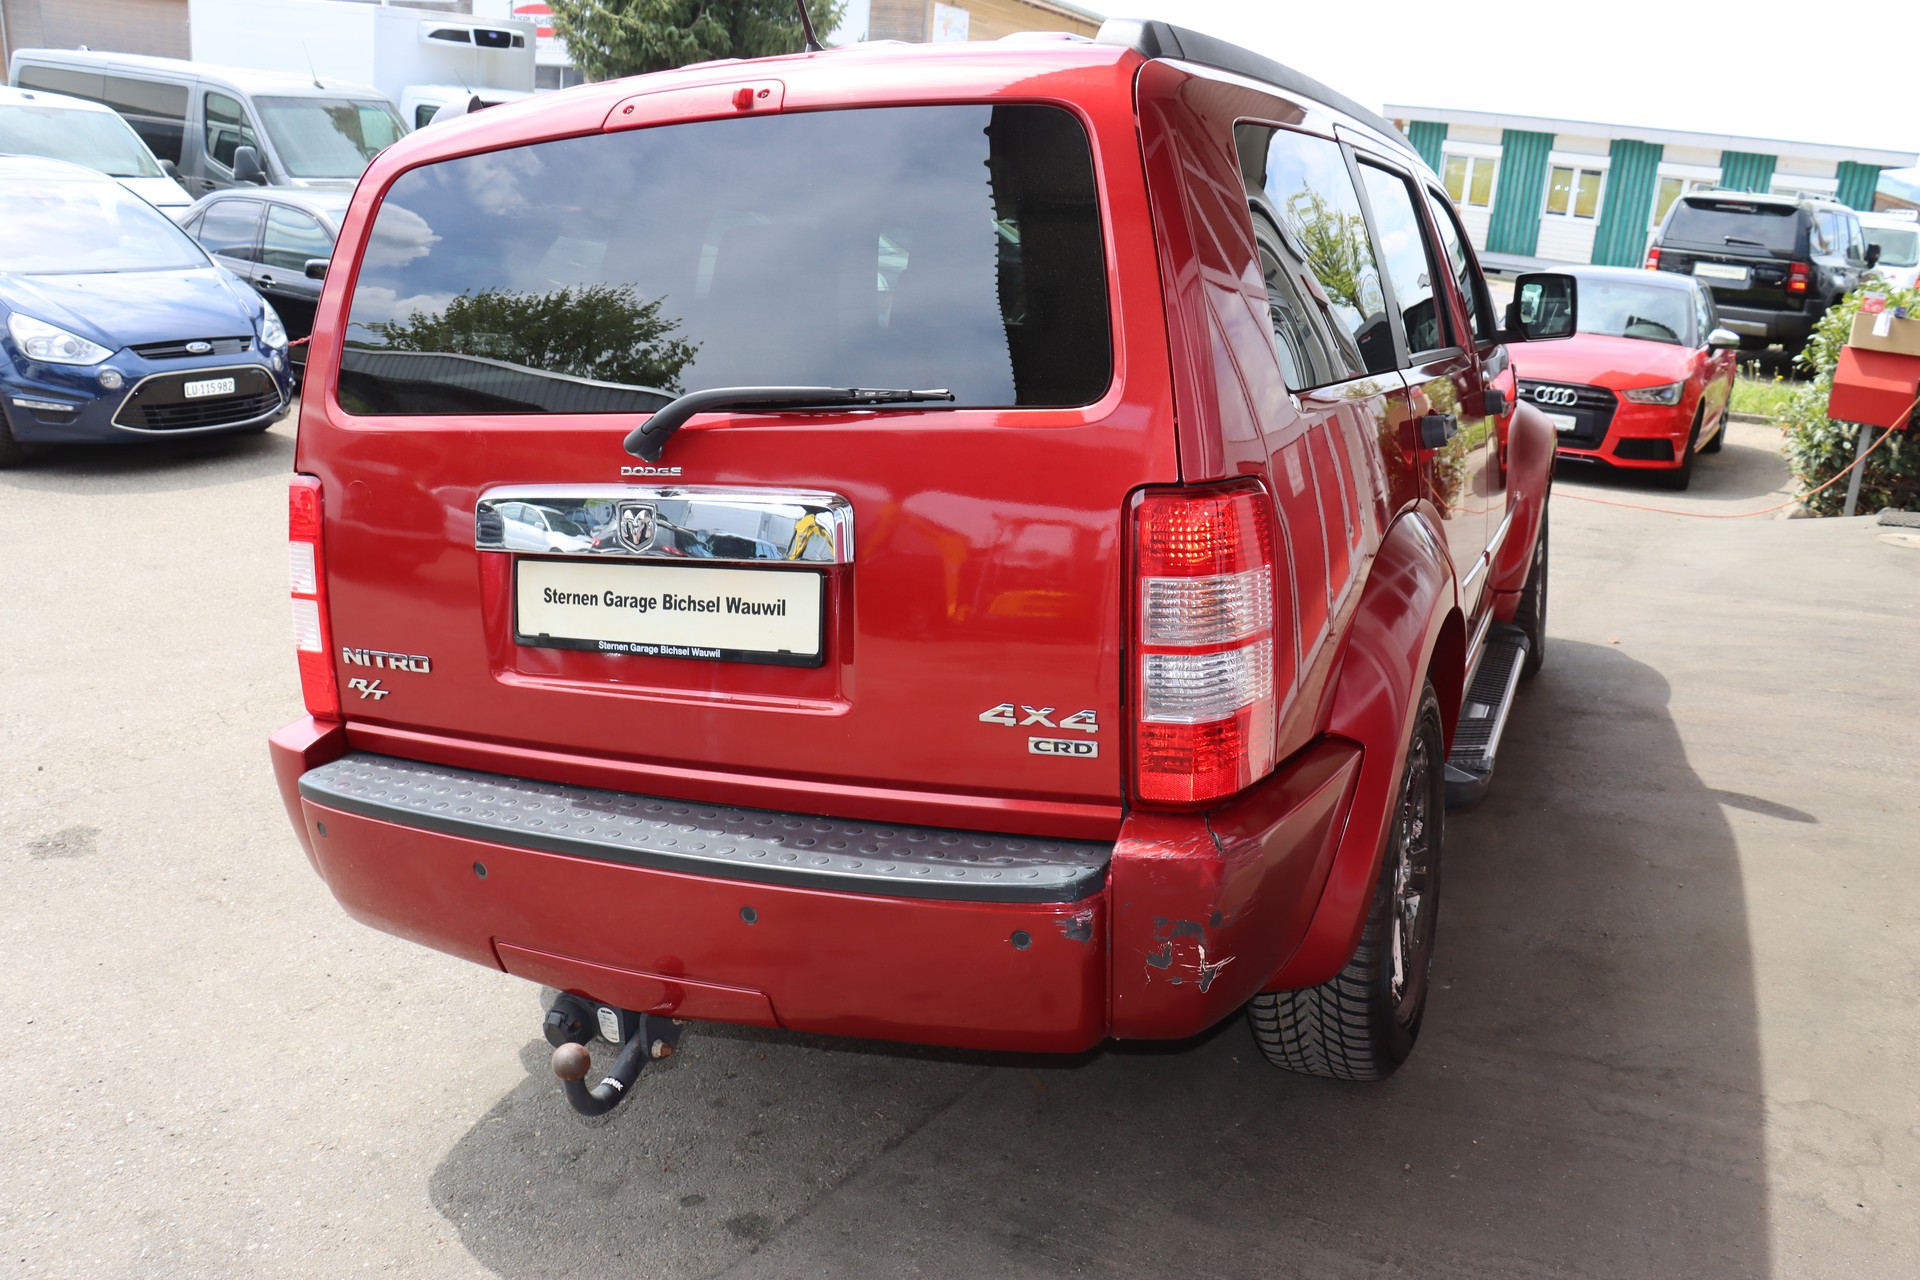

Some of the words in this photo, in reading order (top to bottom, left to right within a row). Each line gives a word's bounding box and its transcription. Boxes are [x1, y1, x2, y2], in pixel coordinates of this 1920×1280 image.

[620, 466, 682, 476] DODGE
[543, 587, 598, 606] Sternen
[603, 590, 657, 613] Garage
[662, 593, 720, 613] Bichsel
[726, 596, 786, 616] Wauwil
[598, 640, 629, 651] Sternen
[630, 643, 659, 655] Garage
[660, 645, 690, 656] Bichsel
[691, 647, 720, 658] Wauwil
[342, 647, 430, 674] NITRO
[347, 677, 389, 701] R/T
[1033, 740, 1093, 754] CRD
